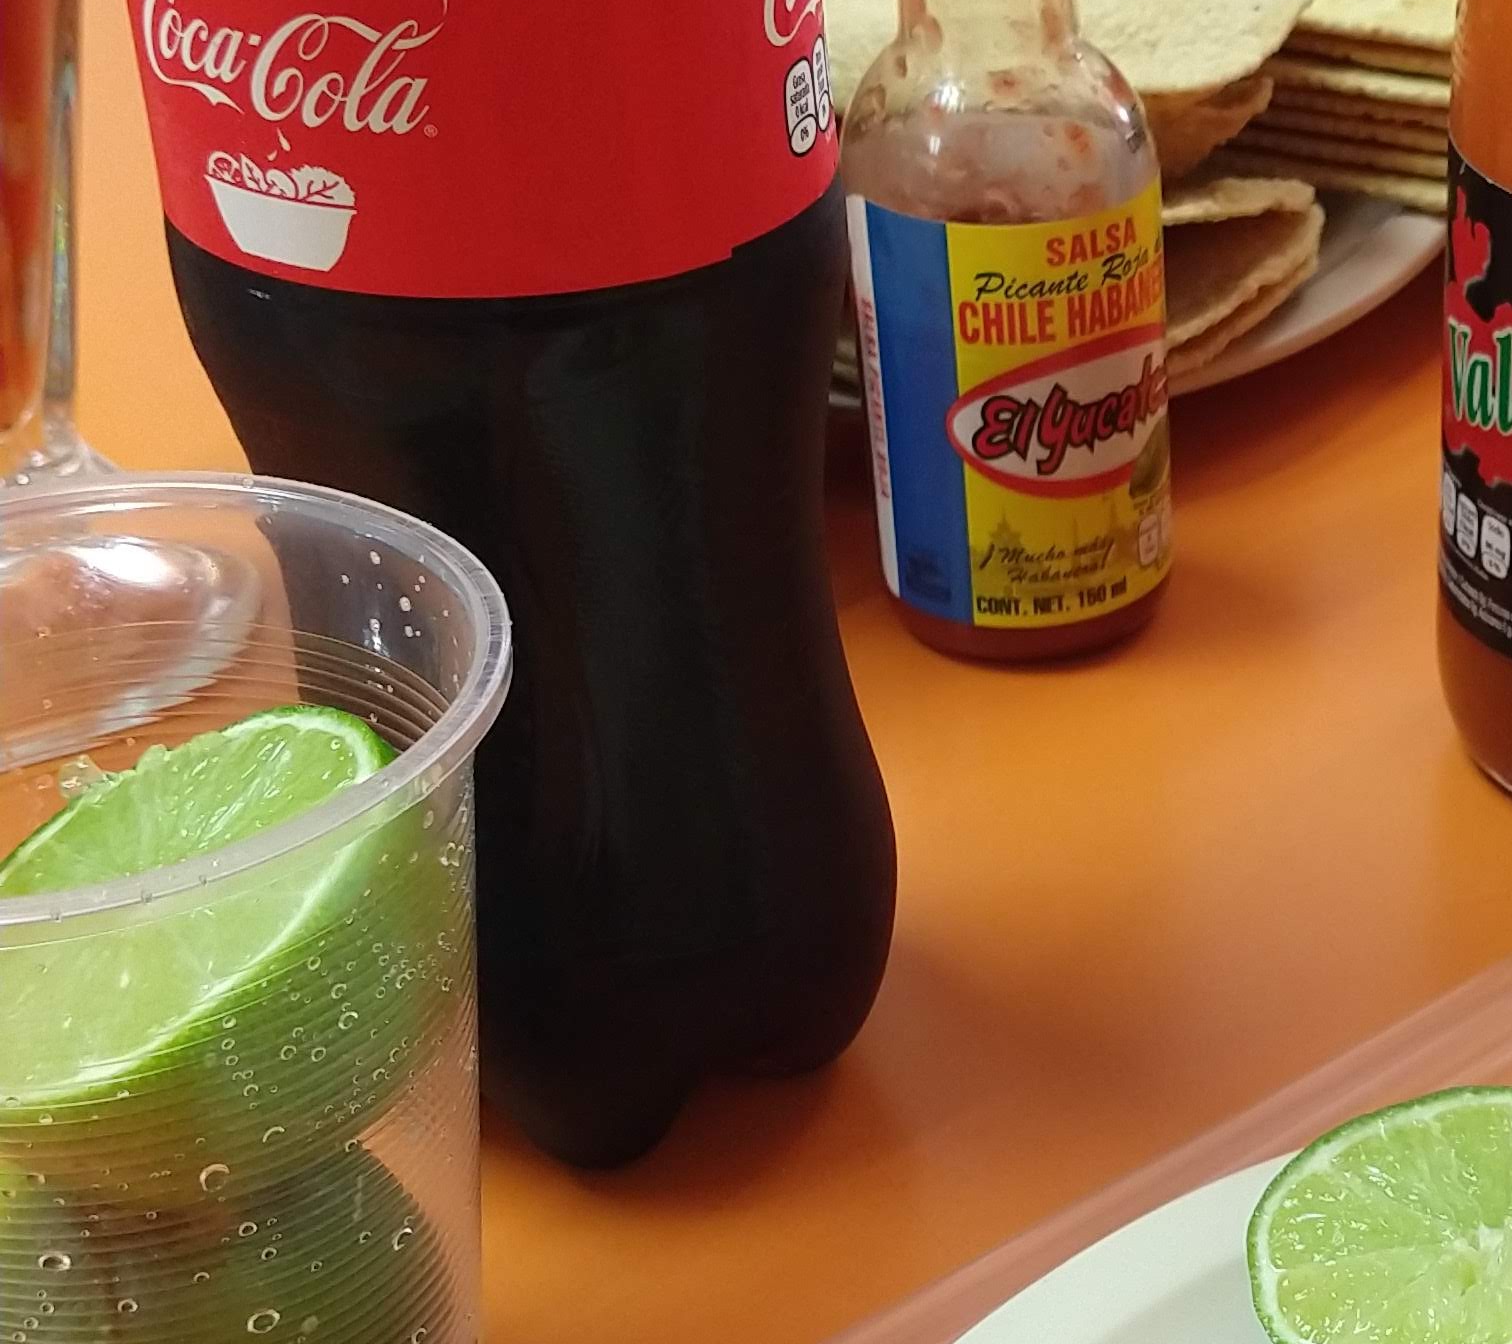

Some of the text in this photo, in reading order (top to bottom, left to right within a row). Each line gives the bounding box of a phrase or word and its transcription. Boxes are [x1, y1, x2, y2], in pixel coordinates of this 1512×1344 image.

[1046, 216, 1137, 267] SALSA
[974, 270, 1089, 302] Picante
[958, 299, 1056, 346] CHILE
